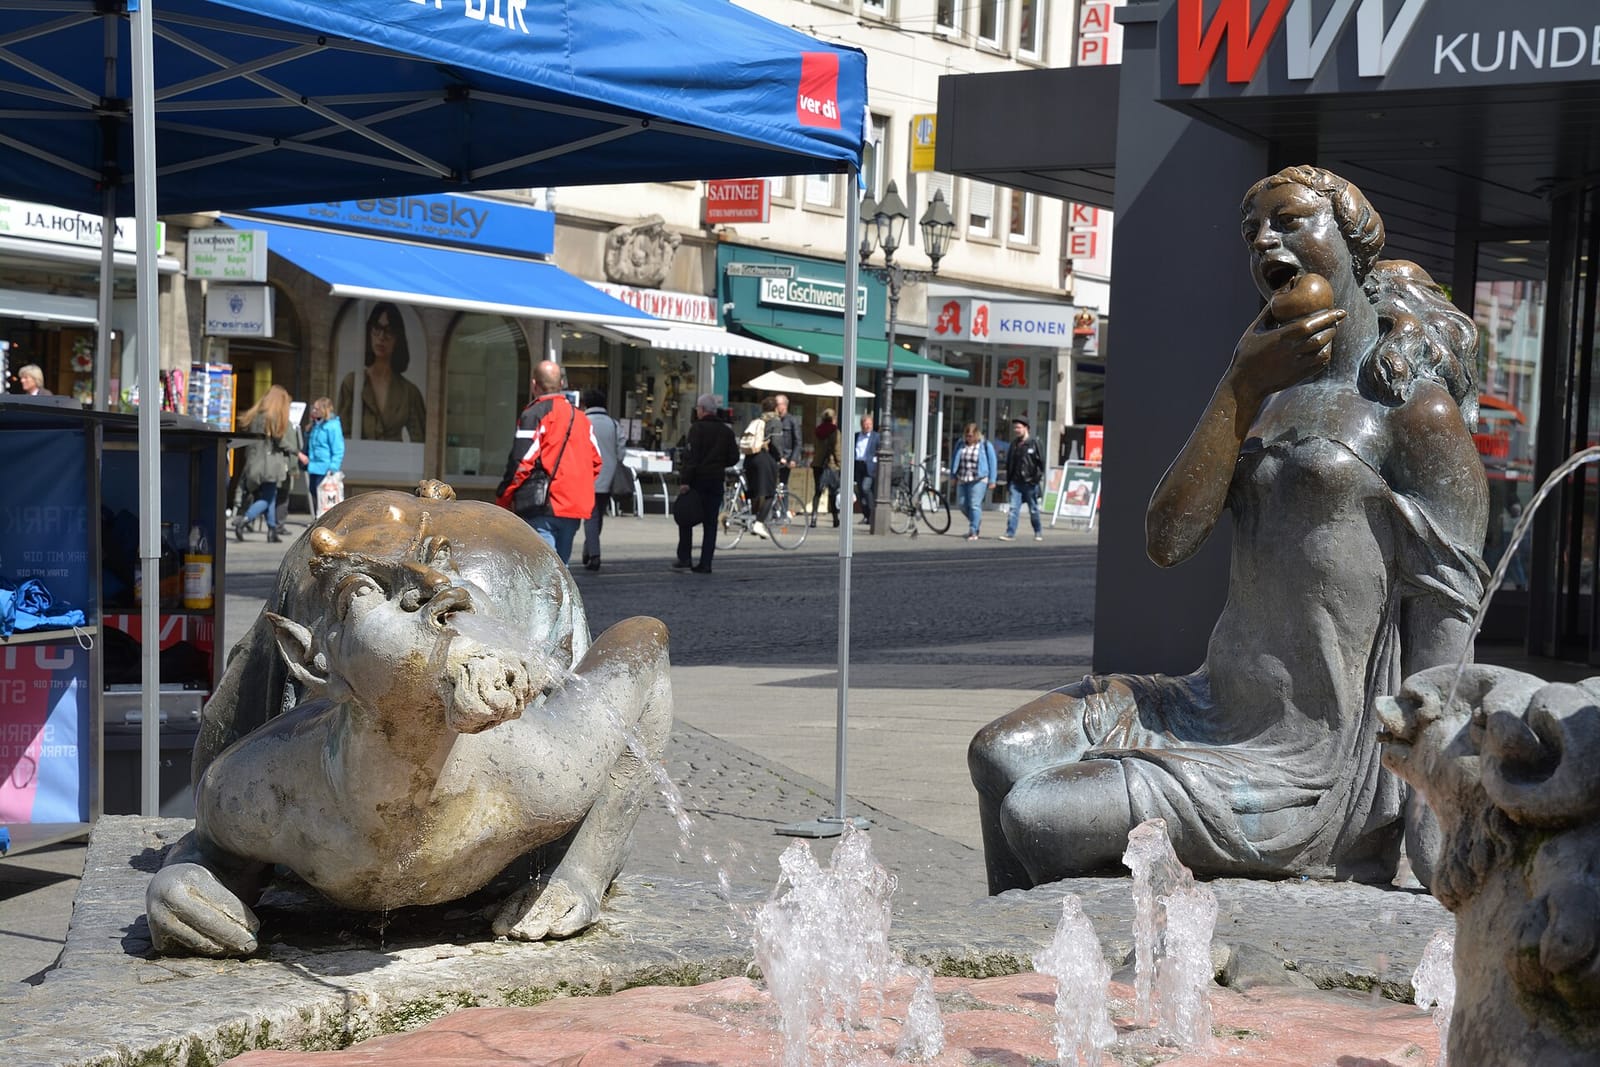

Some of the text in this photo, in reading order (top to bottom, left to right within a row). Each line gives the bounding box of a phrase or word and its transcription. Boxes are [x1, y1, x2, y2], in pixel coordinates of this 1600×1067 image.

[709, 184, 760, 201] SATINEE
[326, 195, 489, 239] esinsky
[620, 289, 717, 321] STRUMPFMODEN
[766, 279, 865, 311] Tee Gschwendr
[208, 320, 263, 332] Kresinsky
[1000, 318, 1066, 336] KRONEN
